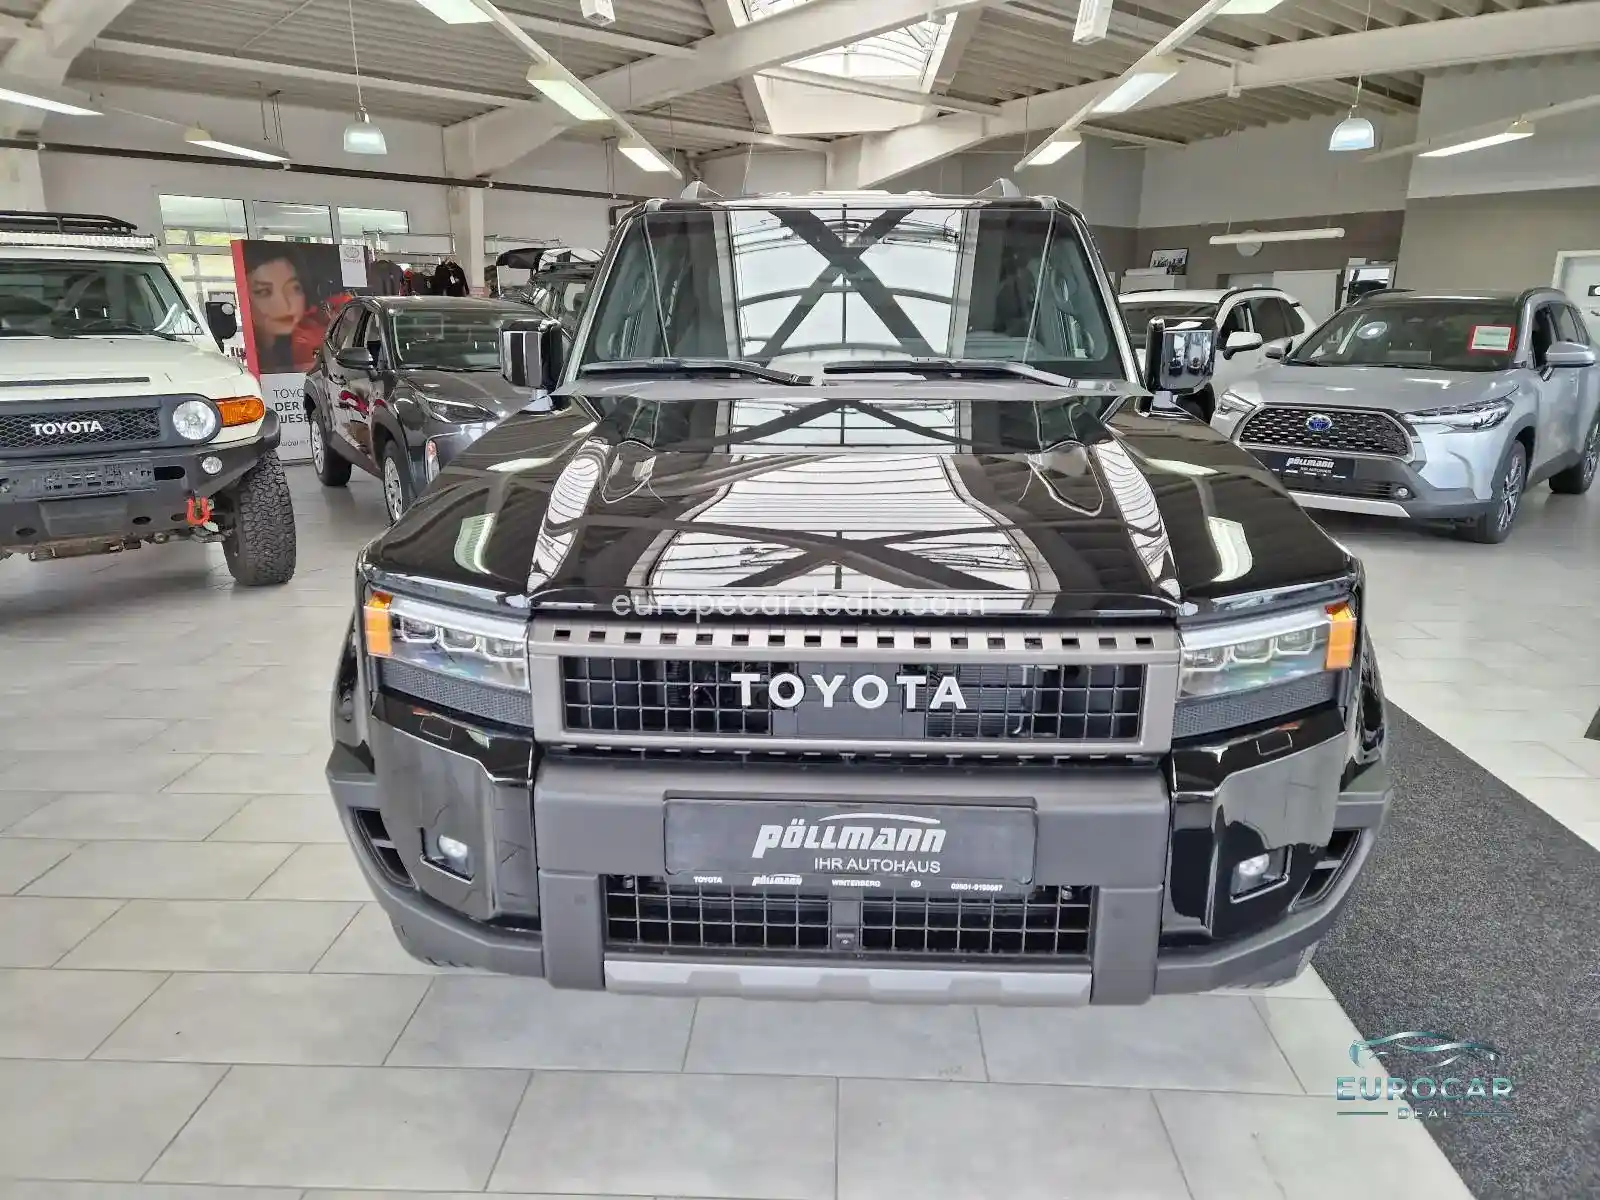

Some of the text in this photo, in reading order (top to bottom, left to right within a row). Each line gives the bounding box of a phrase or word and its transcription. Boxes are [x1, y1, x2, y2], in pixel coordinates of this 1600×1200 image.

[275, 401, 299, 411] DER
[30, 420, 104, 436] TOYOTA
[731, 673, 967, 709] TOYOTA
[814, 857, 941, 874] IHR AUTOHAUS
[693, 876, 723, 884] TOYOTA
[832, 879, 882, 888] WINTERBERG
